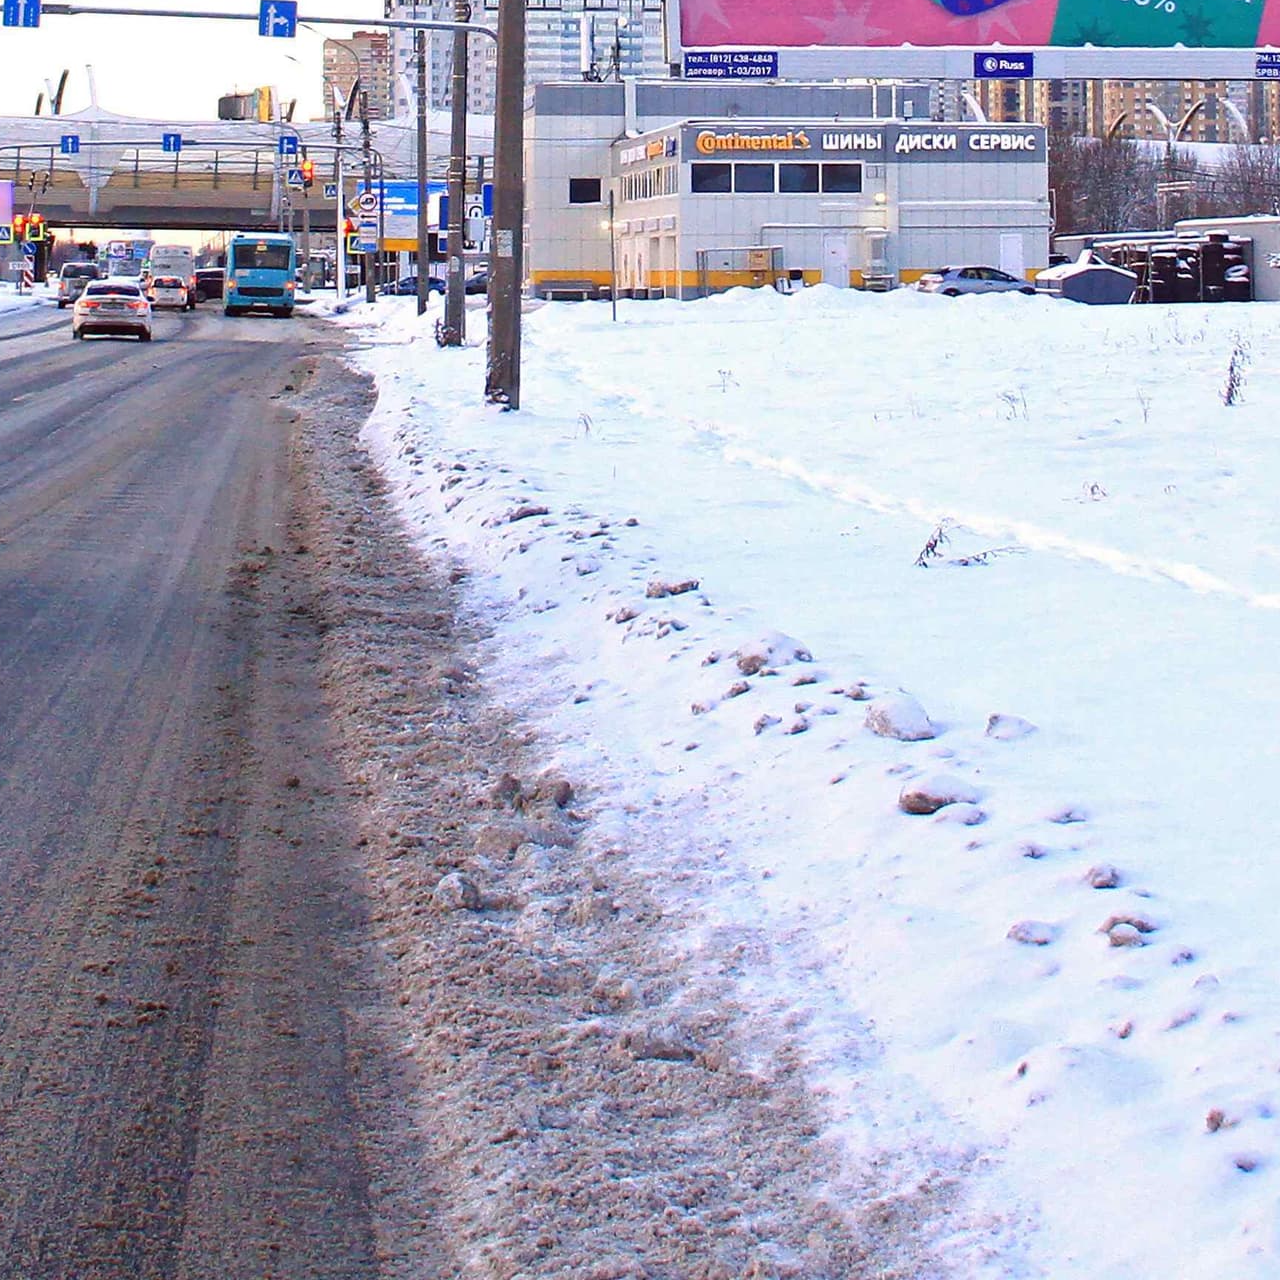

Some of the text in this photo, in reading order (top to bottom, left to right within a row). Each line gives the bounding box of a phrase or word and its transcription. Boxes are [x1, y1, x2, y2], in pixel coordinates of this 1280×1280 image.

[999, 60, 1025, 70] Russ
[696, 130, 1036, 154] Continental ШИНЫ ДИСКИ СЕРВИС
